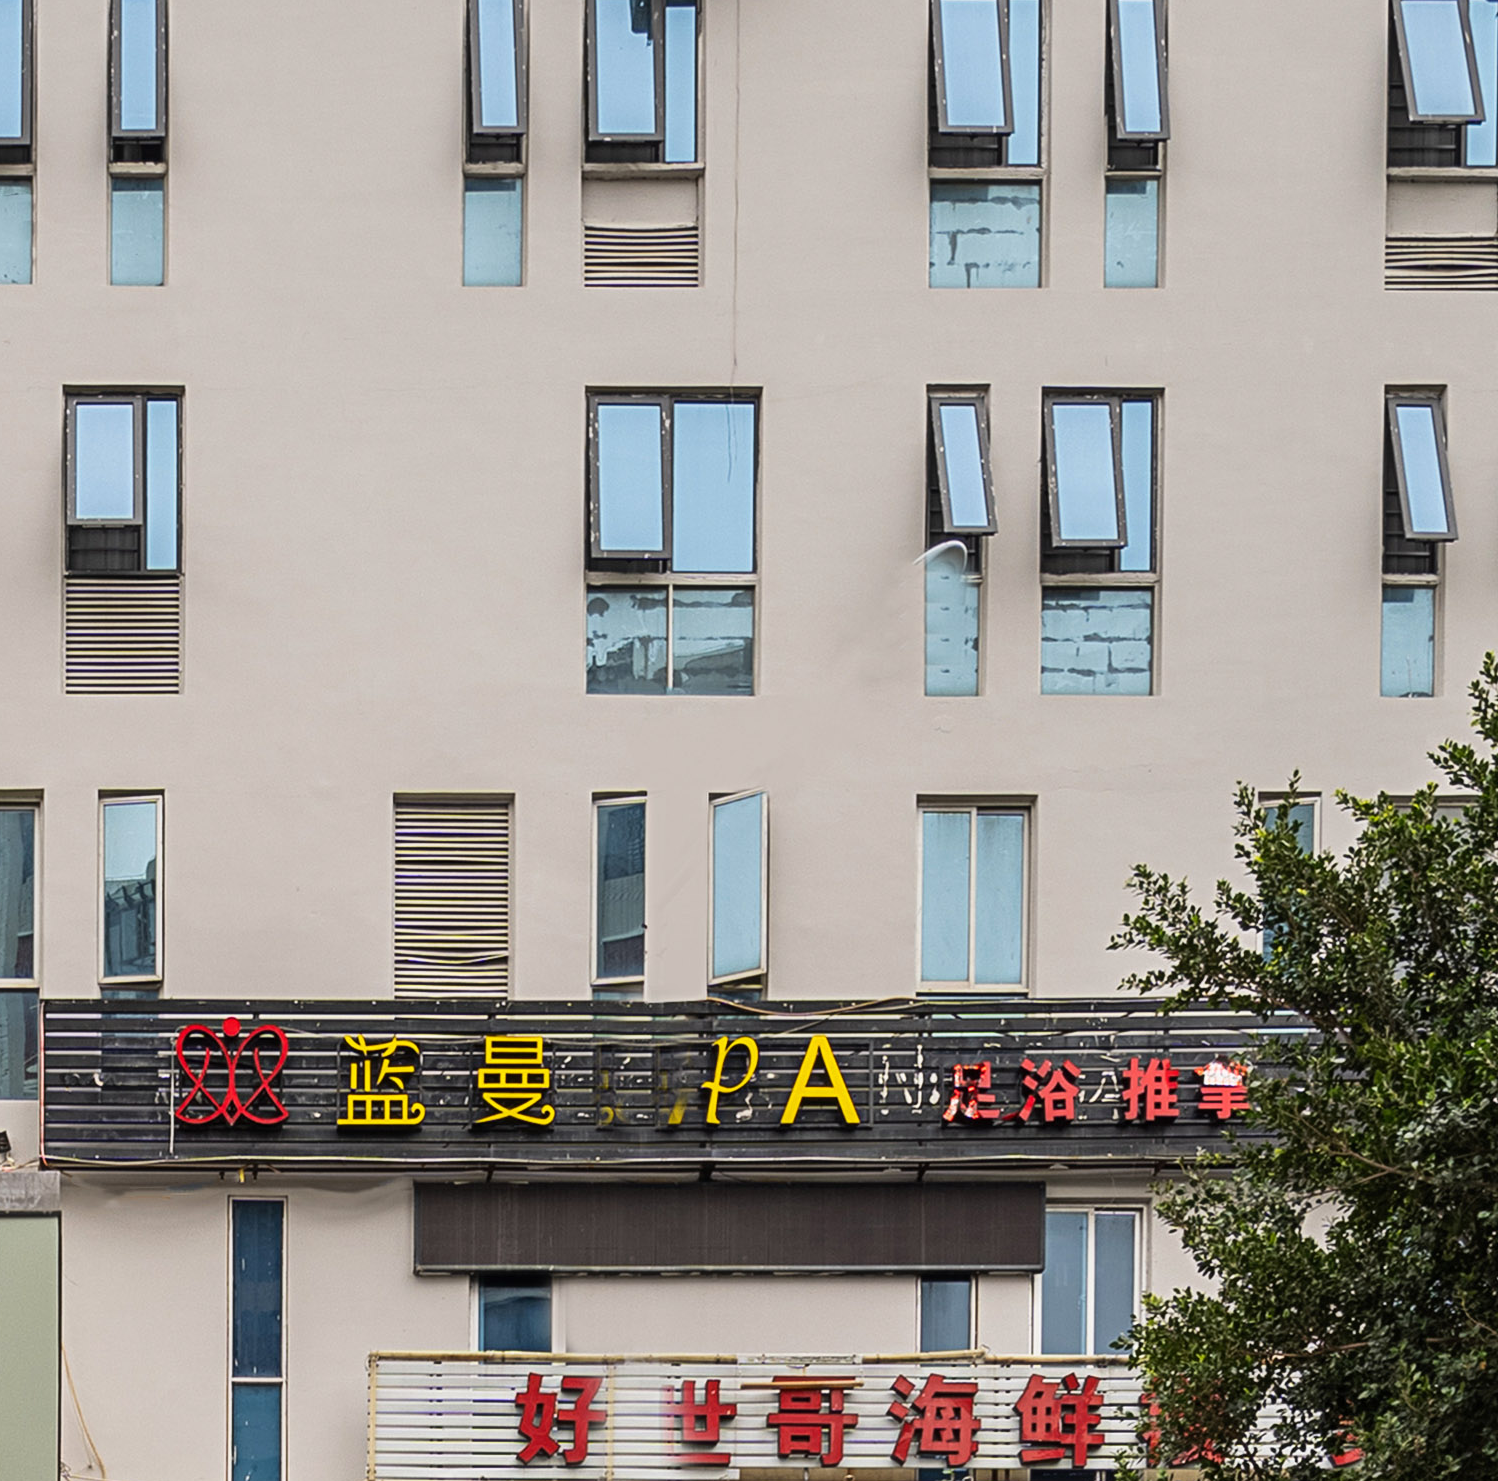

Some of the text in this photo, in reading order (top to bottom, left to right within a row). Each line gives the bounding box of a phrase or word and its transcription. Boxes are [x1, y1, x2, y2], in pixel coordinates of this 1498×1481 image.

[339, 1036, 554, 1127] 蓝曼
[515, 1372, 1228, 1469] 好世哥海鲜
